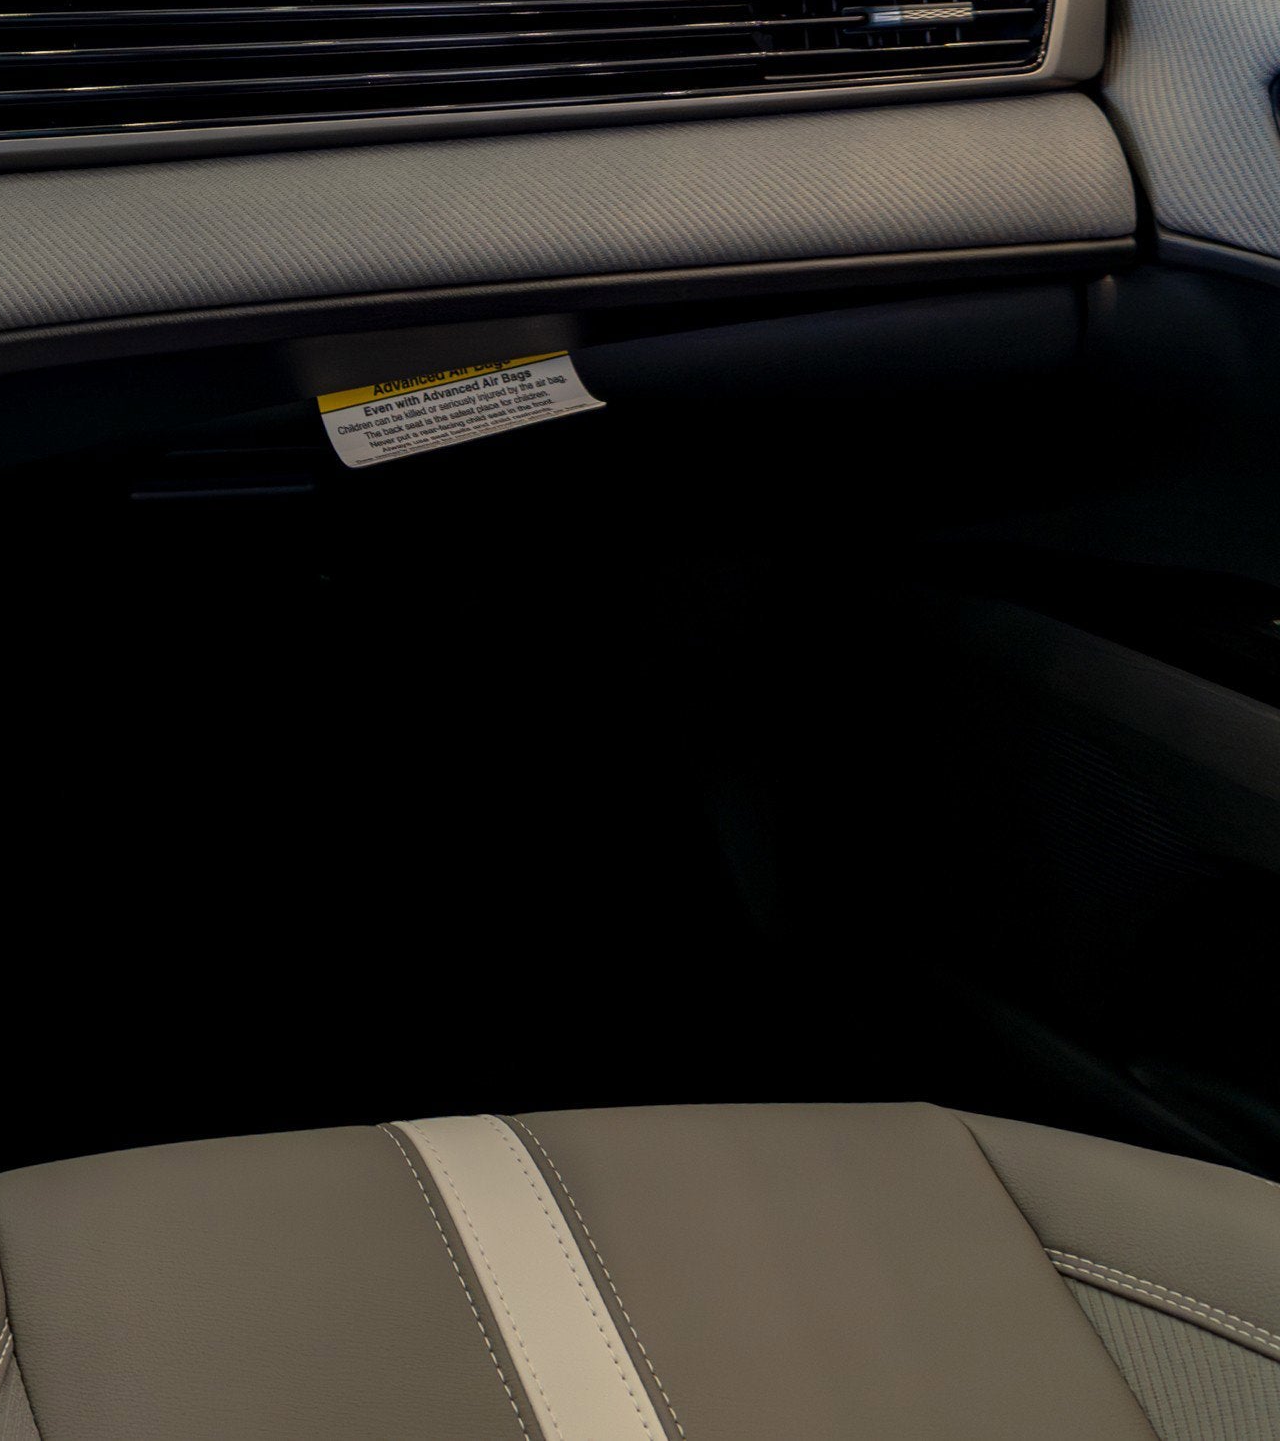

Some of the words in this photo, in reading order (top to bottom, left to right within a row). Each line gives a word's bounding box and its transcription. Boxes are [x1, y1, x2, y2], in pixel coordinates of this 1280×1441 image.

[337, 421, 373, 435] Children
[374, 417, 391, 427] can
[392, 412, 403, 422] be
[404, 407, 427, 420] killed
[428, 404, 437, 412] or
[439, 394, 476, 411] seriously
[478, 388, 506, 403] injured
[508, 385, 519, 396] by
[519, 381, 534, 390] the
[536, 379, 547, 388] air
[548, 374, 567, 386] bag.
[363, 403, 393, 417] Even
[395, 395, 420, 408] with
[423, 381, 479, 403] Advanced
[482, 376, 498, 388] Air
[502, 369, 532, 383] Bags
[364, 430, 381, 440] The
[384, 425, 403, 436] back
[404, 421, 423, 431] seat
[433, 414, 448, 423] the
[476, 403, 499, 416] place
[500, 399, 512, 409] for
[514, 390, 550, 404] children.
[369, 438, 395, 449] Never
[397, 434, 410, 444] put
[466, 414, 486, 425] child
